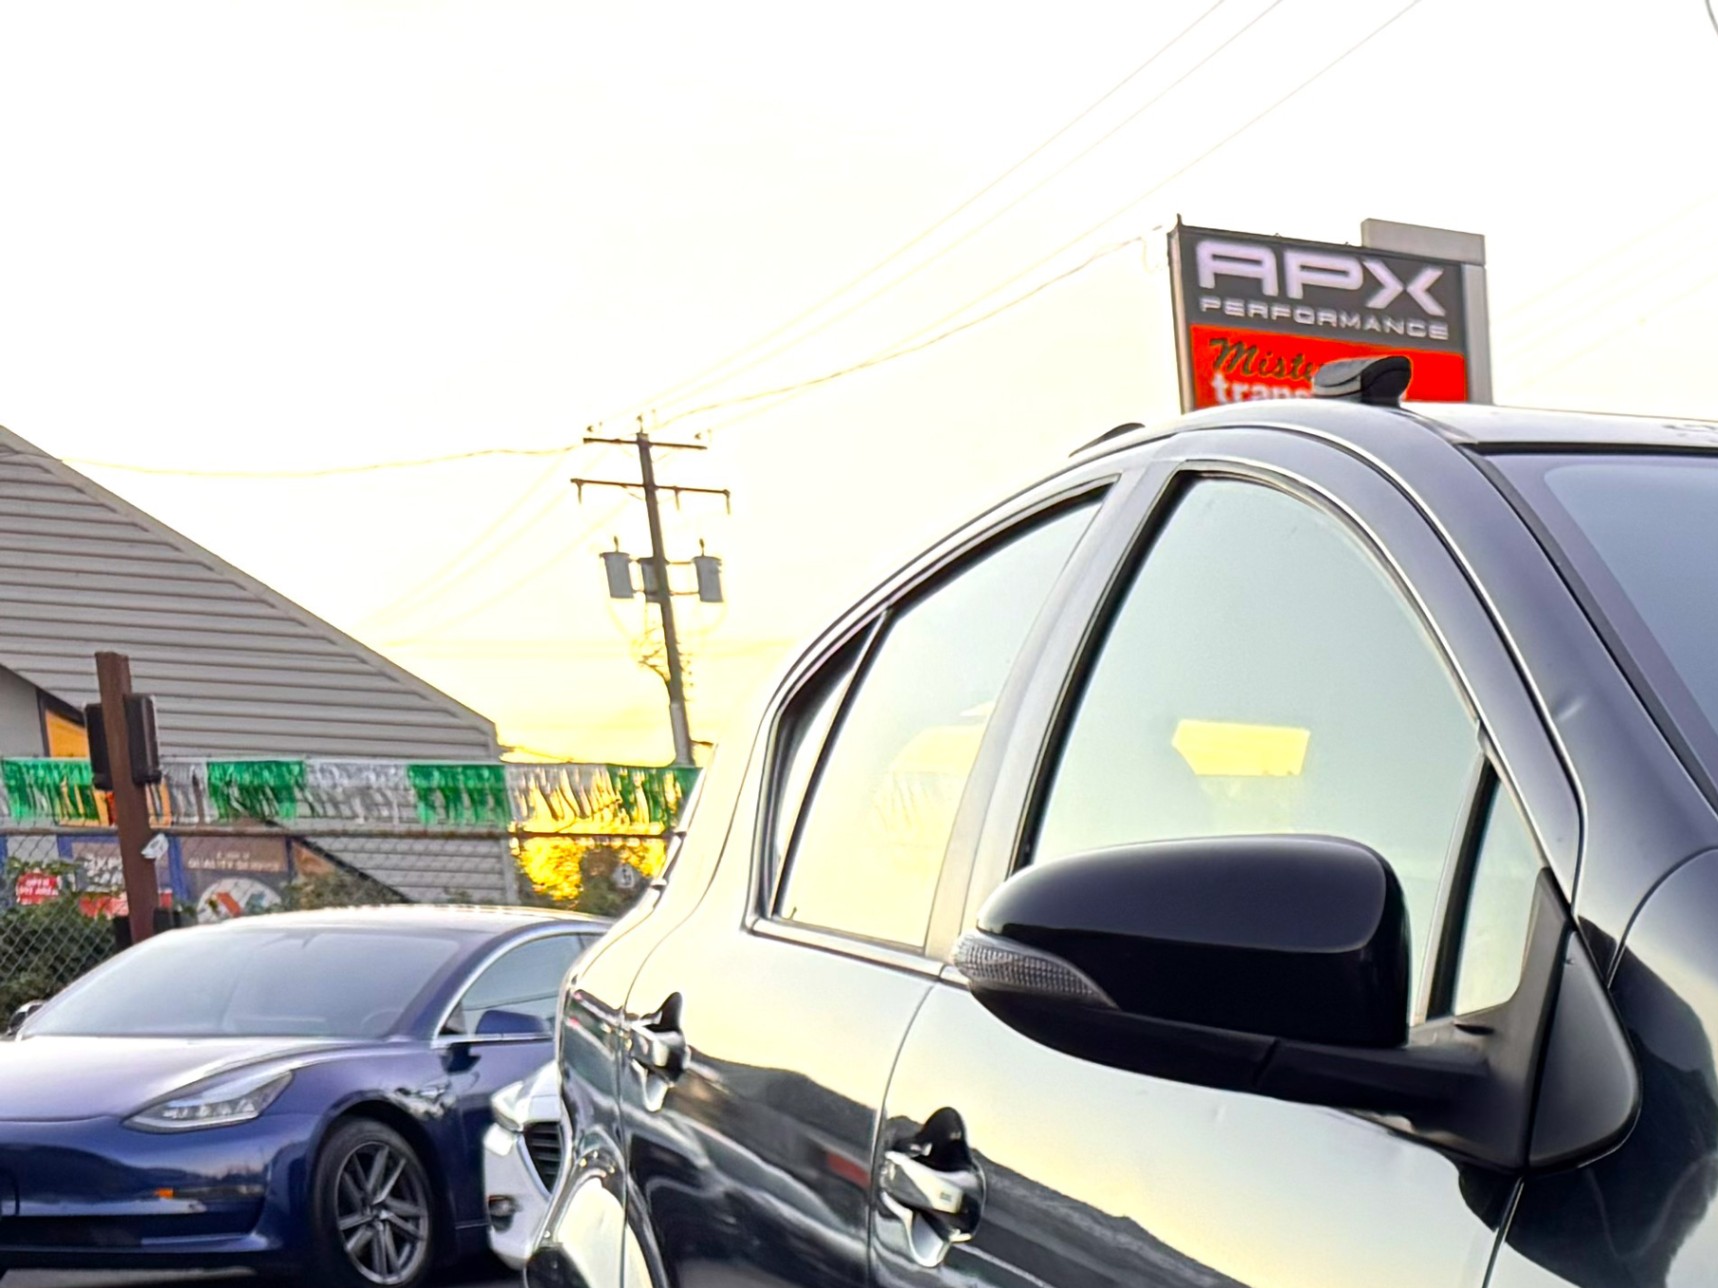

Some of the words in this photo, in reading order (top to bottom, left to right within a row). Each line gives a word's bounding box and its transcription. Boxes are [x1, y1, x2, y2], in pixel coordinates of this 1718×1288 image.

[1196, 240, 1446, 316] APX
[1201, 297, 1448, 341] PERFORMANCE
[1210, 337, 1326, 382] Miste
